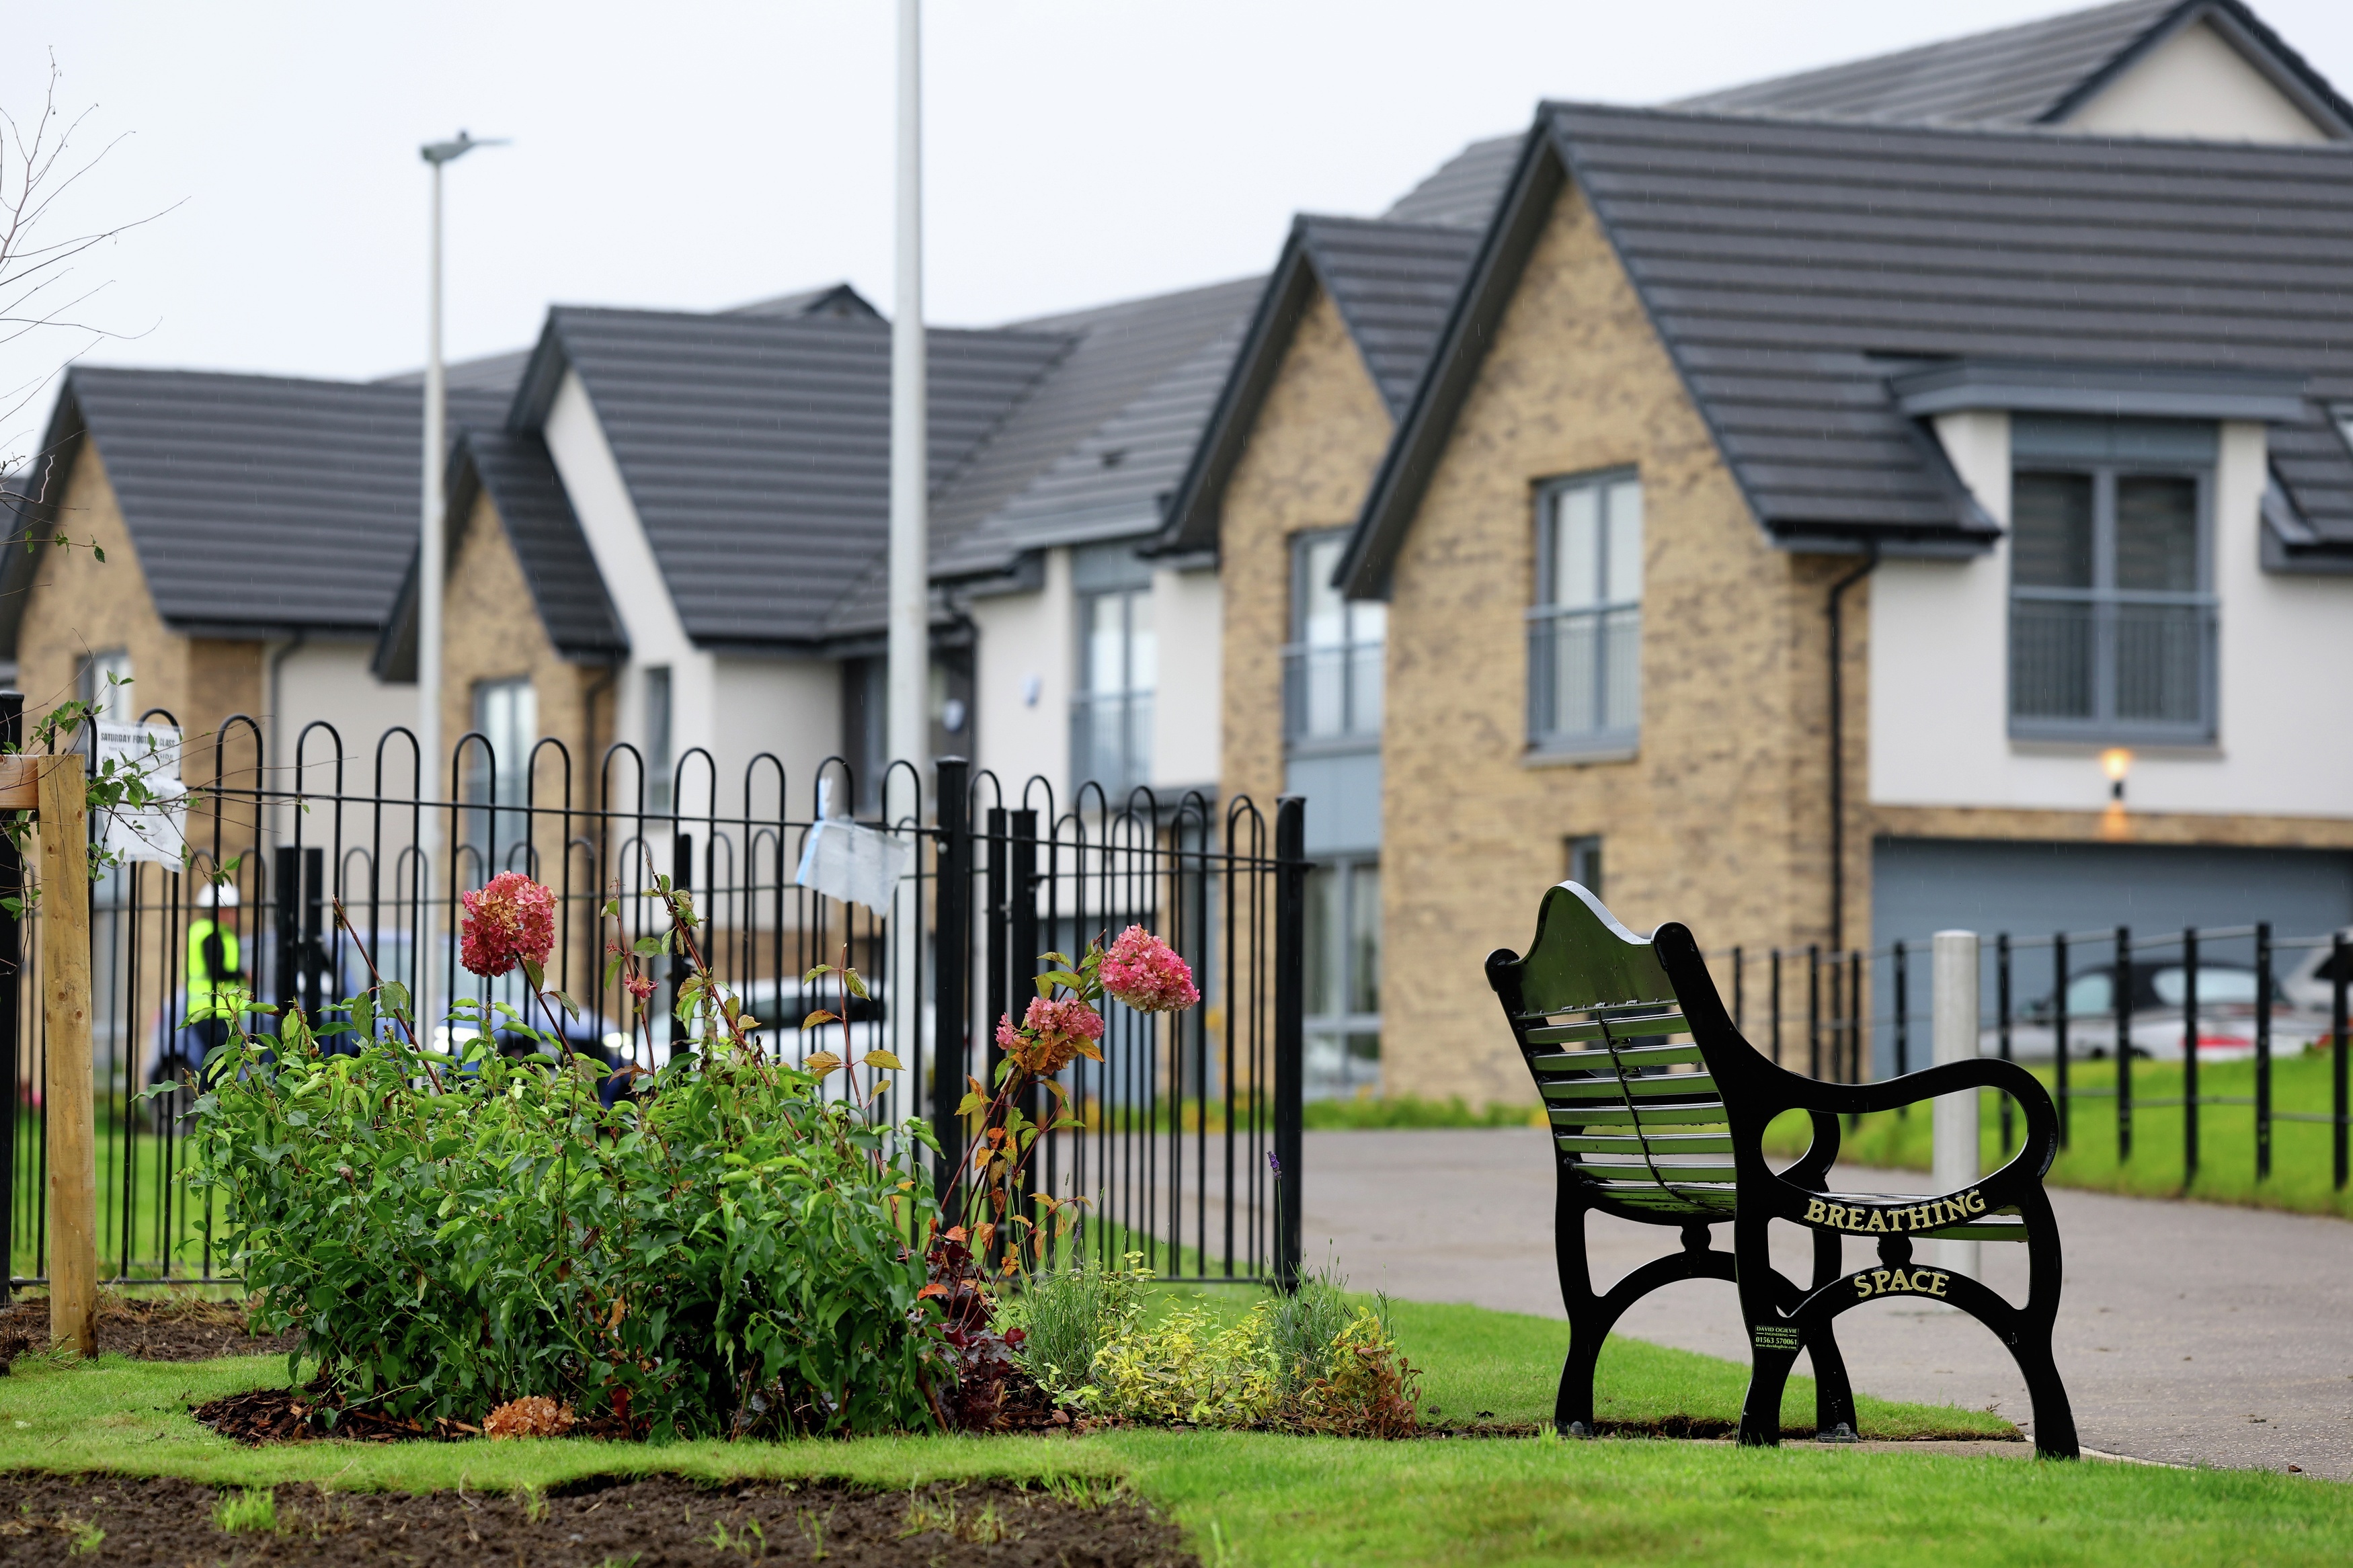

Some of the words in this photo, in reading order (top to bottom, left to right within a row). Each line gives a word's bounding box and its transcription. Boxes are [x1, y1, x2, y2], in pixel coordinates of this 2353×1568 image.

[101, 733, 131, 743] SATURDAY
[159, 737, 175, 747] CLASS
[1804, 1190, 1986, 1232] BREATHING
[1853, 1269, 1949, 1297] SPACE
